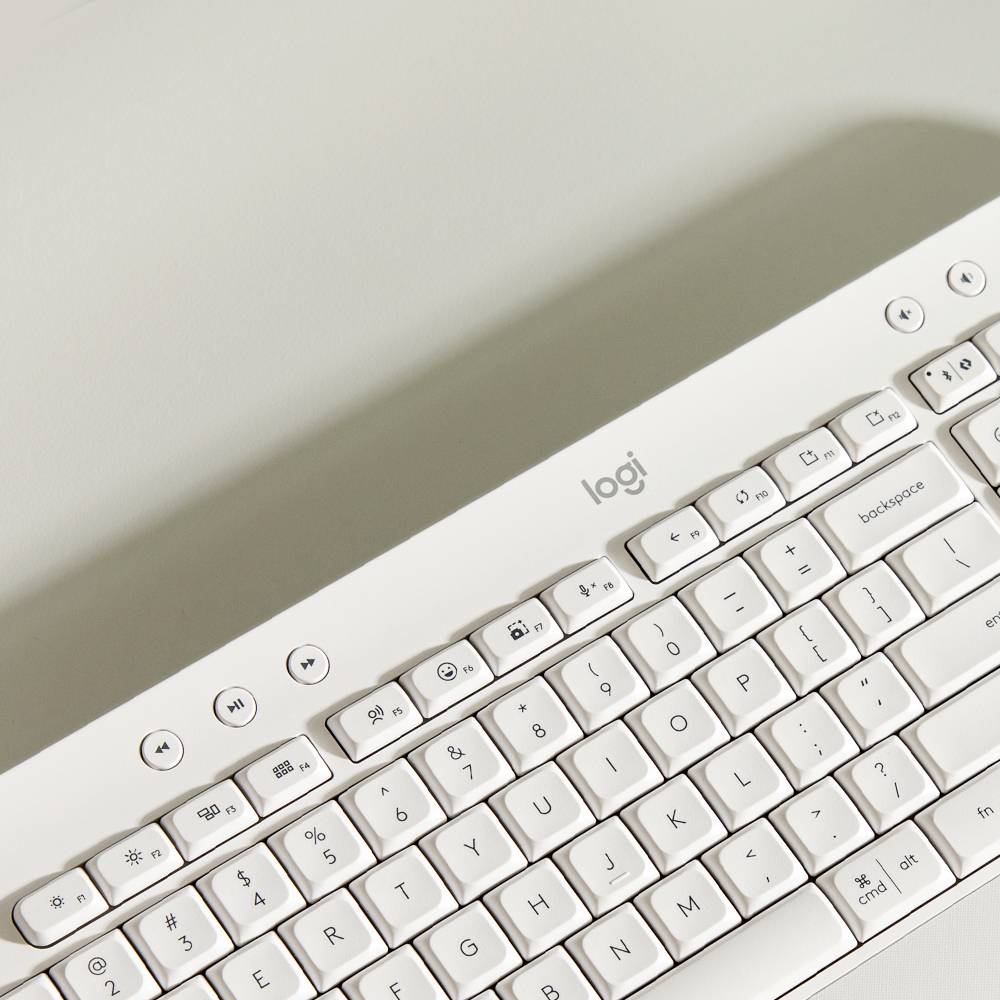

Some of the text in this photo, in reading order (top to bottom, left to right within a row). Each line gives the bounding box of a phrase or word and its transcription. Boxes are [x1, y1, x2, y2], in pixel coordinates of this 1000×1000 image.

[887, 411, 902, 422] F12
[823, 450, 836, 461] F11
[581, 451, 648, 505] logi
[755, 490, 769, 501] F10
[857, 479, 925, 525] backspace
[689, 530, 700, 540] F9
[785, 545, 796, 556] +
[797, 564, 812, 575] =
[602, 581, 614, 592] F8
[533, 622, 543, 633] F7
[653, 623, 665, 637] )
[666, 641, 681, 656] 0
[462, 664, 474, 674] F6
[587, 662, 600, 677] (
[599, 682, 612, 697] 9
[736, 673, 750, 693] P
[391, 706, 404, 717] F5
[531, 723, 547, 739] 8
[669, 714, 688, 733] O
[446, 745, 467, 761] &
[298, 762, 311, 772] F4
[462, 764, 474, 780] 7
[874, 762, 887, 777] ?
[733, 772, 752, 788] L
[225, 804, 237, 816] F3
[532, 795, 552, 815] U
[977, 806, 995, 819] fn
[395, 807, 408, 822] 6
[666, 809, 687, 829] K
[304, 826, 327, 845] %
[150, 849, 163, 860] F2
[463, 838, 480, 857] Y
[322, 848, 337, 865] 5
[604, 852, 615, 871] J
[899, 854, 919, 871] alt
[237, 869, 251, 888] $
[76, 893, 86, 904] F1
[254, 891, 266, 906] 4
[394, 881, 410, 900] T
[858, 880, 888, 905] cmd
[527, 893, 550, 916] H
[676, 895, 701, 918] M
[164, 912, 177, 932] #
[177, 935, 193, 952] 3
[322, 926, 345, 946] R
[459, 938, 479, 957] G
[609, 938, 632, 961] N
[87, 956, 107, 976] @
[251, 969, 271, 990] E
[104, 979, 121, 997] 2
